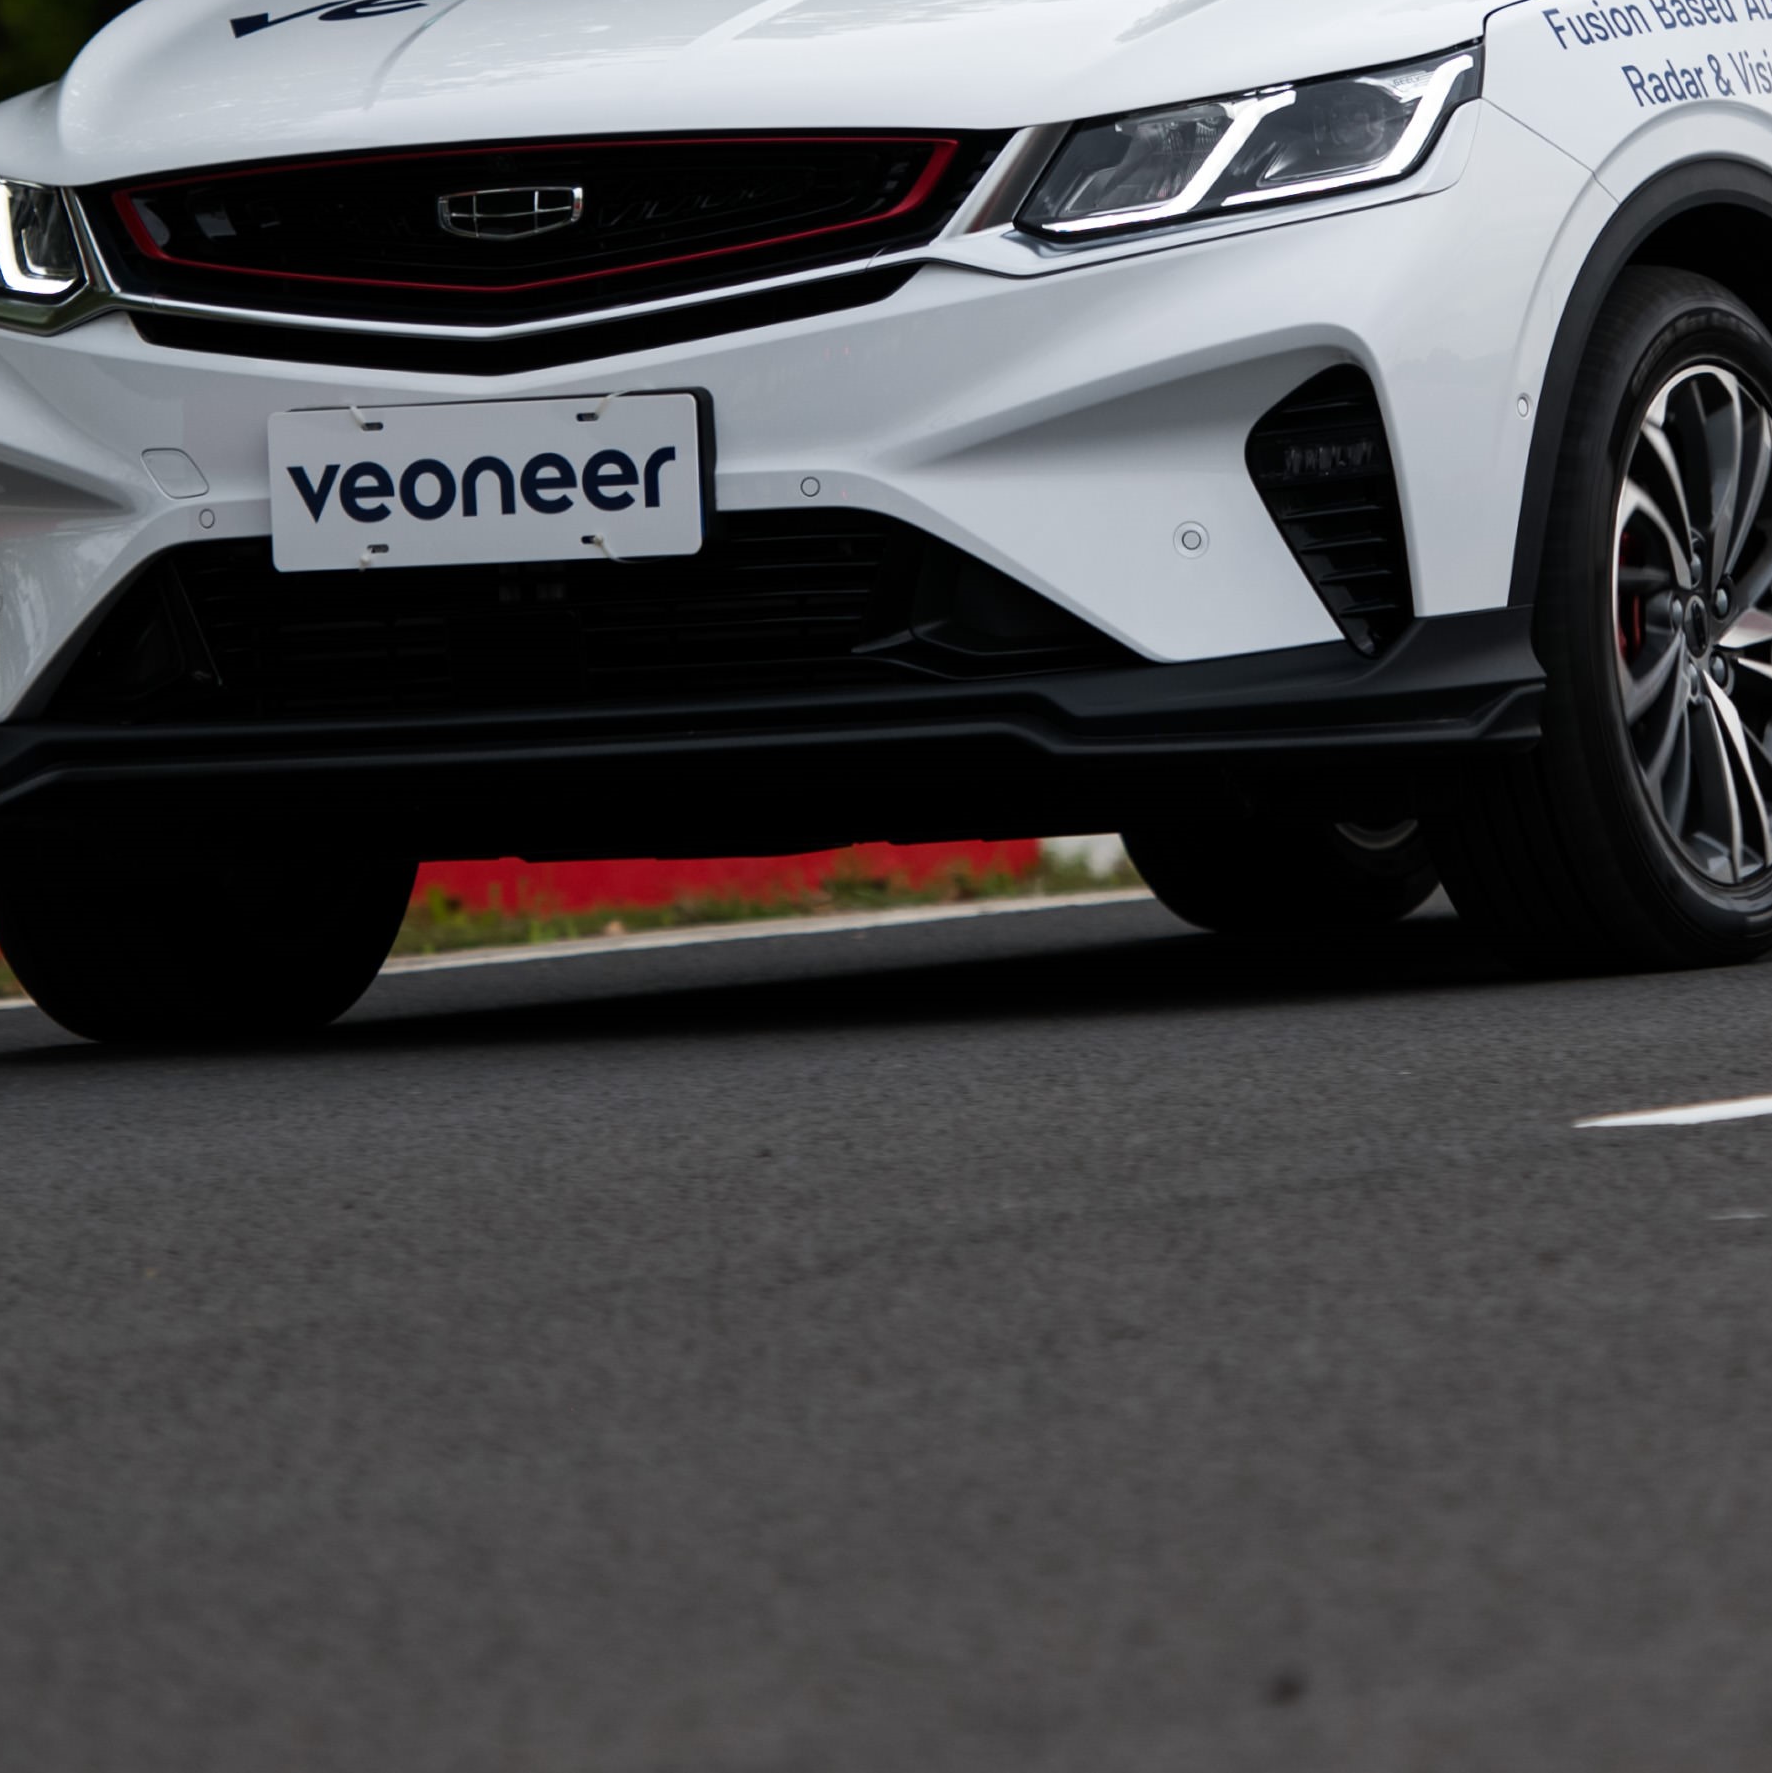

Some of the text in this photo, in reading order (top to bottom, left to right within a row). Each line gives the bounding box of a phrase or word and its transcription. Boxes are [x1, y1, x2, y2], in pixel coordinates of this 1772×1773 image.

[1542, 0, 1652, 50] Fusion
[1621, 59, 1709, 108] Radar
[1707, 54, 1736, 97] &
[287, 445, 676, 524] veoneer
